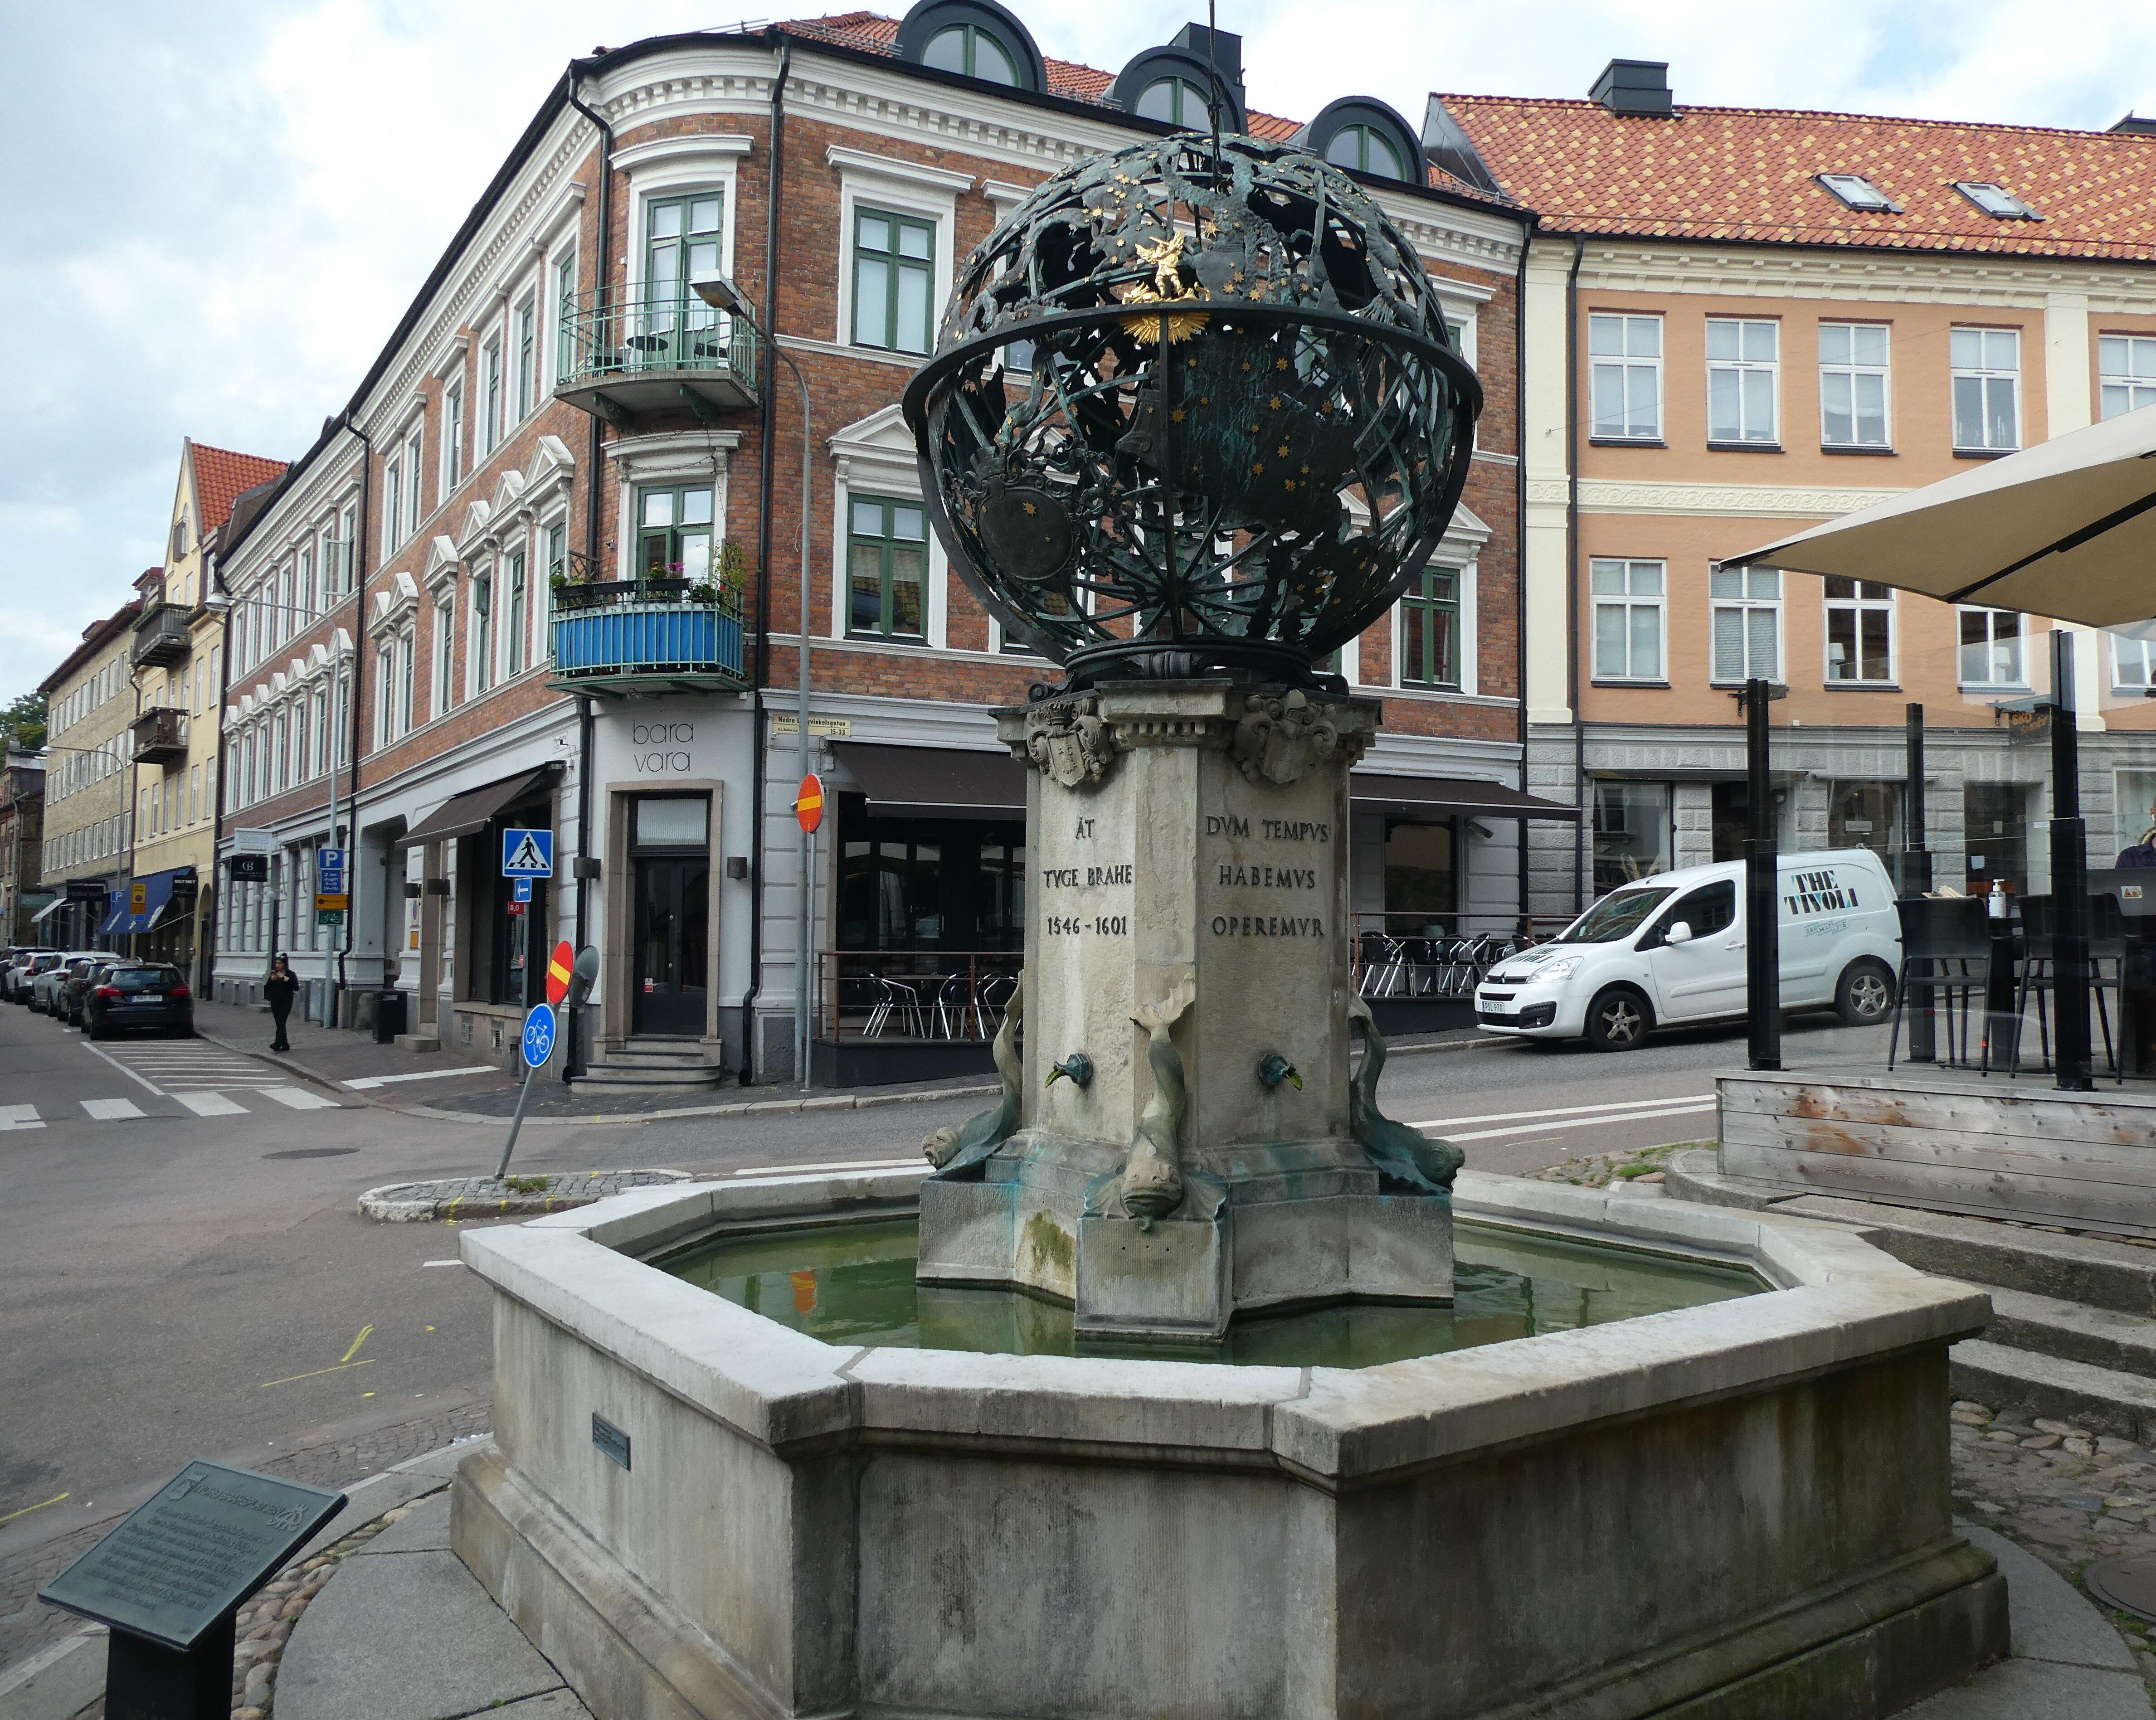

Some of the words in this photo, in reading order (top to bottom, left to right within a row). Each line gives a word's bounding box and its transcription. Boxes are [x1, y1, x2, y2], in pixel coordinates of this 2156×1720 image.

[633, 719, 694, 745] bara
[634, 750, 691, 773] vara
[1207, 816, 1250, 837] DVM
[1262, 819, 1329, 842] TEMPVS
[326, 851, 338, 867] P
[1043, 868, 1079, 888] TYGE
[1087, 864, 1133, 886] BRAHE
[1219, 865, 1316, 889] HABEMVS
[1790, 870, 1839, 893] THE
[1783, 888, 1859, 915] TIVOLI
[1212, 916, 1325, 937] OPEREMVR
